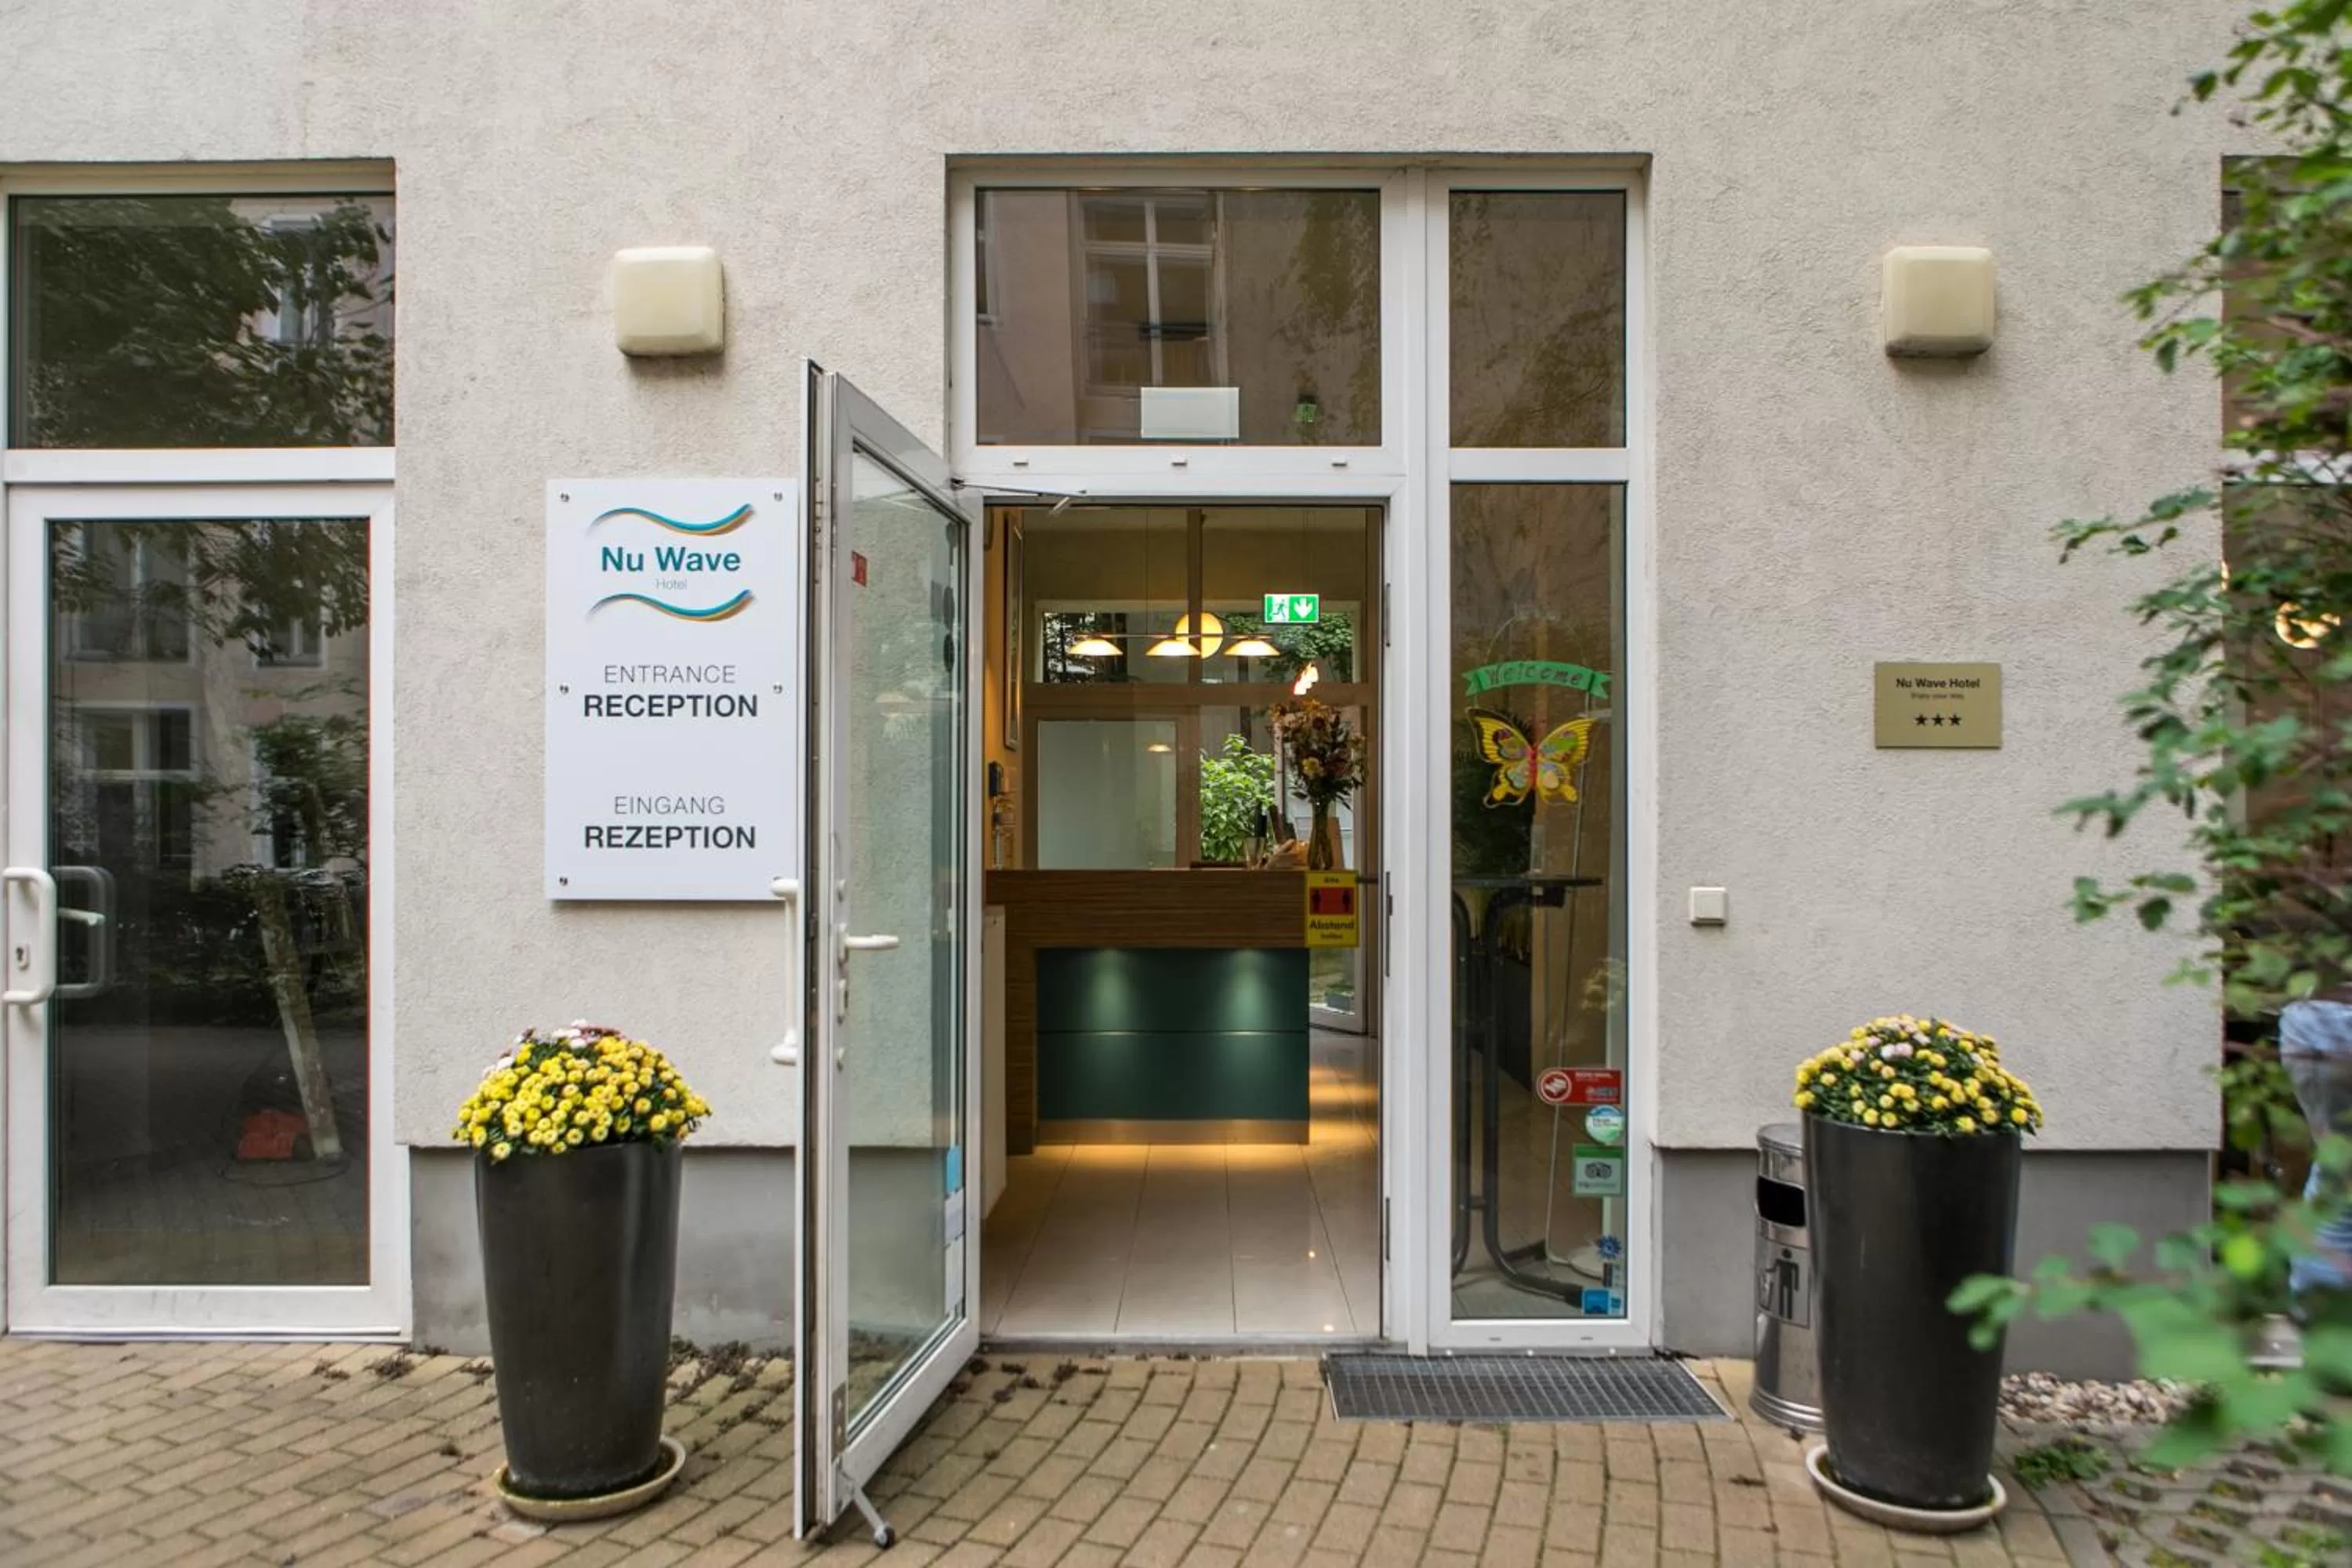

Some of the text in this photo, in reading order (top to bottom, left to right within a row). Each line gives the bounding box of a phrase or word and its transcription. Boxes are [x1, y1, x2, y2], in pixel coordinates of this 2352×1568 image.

[601, 546, 742, 572] Nu Wave
[655, 578, 688, 590] Hotel
[604, 665, 736, 684] ENTRANCE
[1896, 677, 1980, 688] Nu Wave Hotel
[584, 694, 758, 717] RECEPTION
[614, 796, 725, 815] EINGANG
[584, 826, 756, 849] REZEPTION
